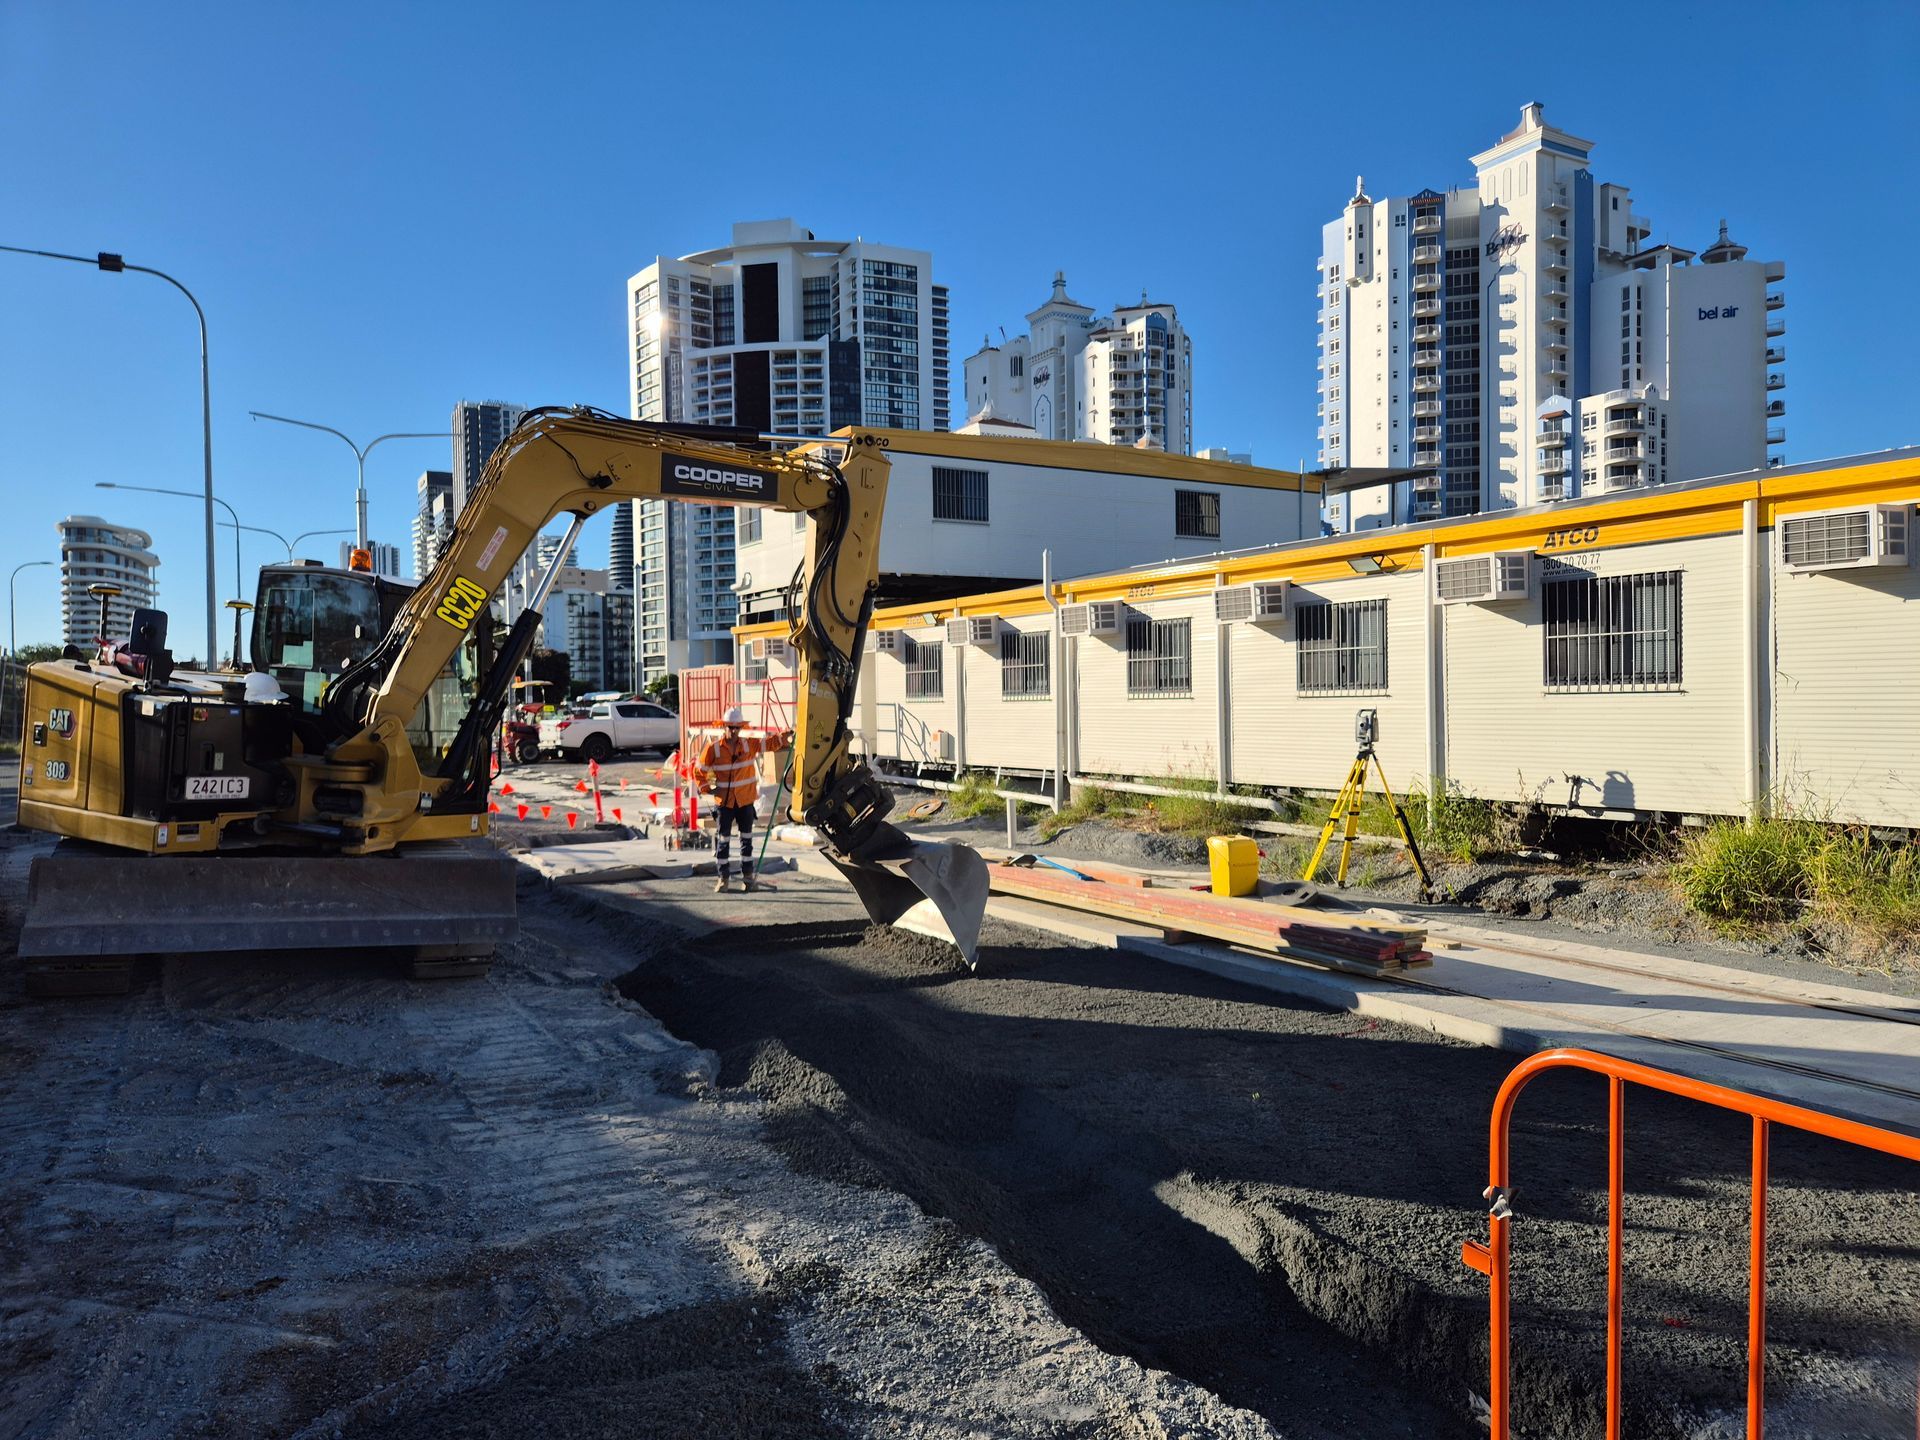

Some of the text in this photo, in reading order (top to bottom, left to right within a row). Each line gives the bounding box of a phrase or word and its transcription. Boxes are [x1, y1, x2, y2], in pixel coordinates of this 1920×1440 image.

[1698, 305, 1739, 320] bel air
[875, 437, 890, 448] CO
[674, 464, 763, 489] COOPER
[703, 482, 733, 493] CIVIL
[1543, 526, 1600, 549] ATCO
[1542, 552, 1601, 570] 1800 70 70 77
[436, 576, 487, 630] CC20
[49, 709, 71, 731] CAT
[46, 761, 66, 780] 308
